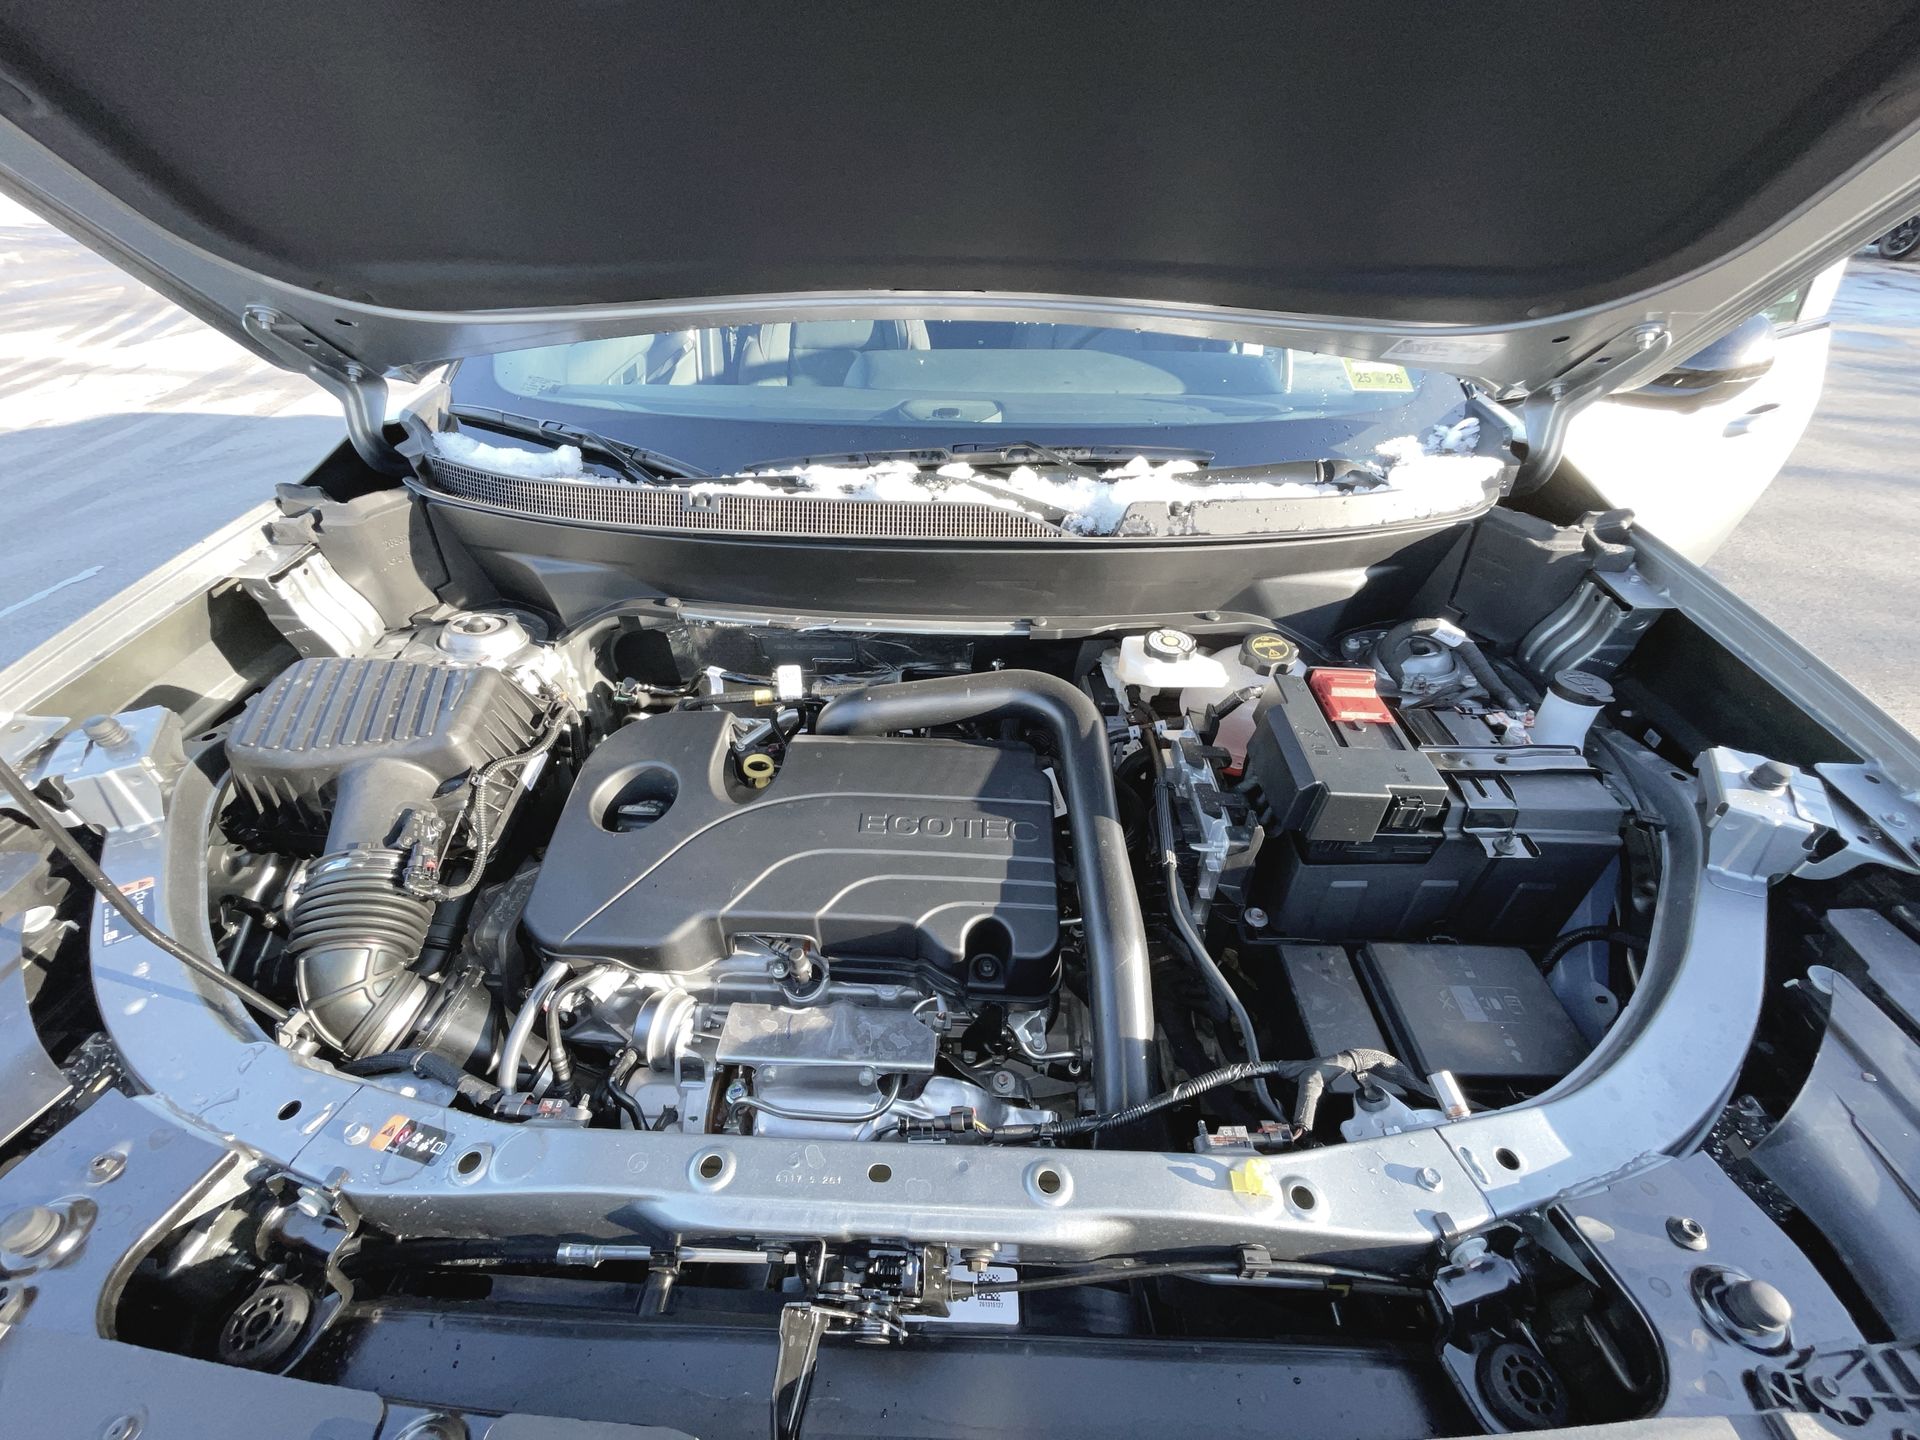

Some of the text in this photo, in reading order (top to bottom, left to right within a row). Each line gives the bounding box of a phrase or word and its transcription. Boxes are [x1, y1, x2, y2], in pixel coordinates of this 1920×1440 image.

[1355, 372, 1403, 384] 25 26
[858, 812, 1040, 842] ECOTEC
